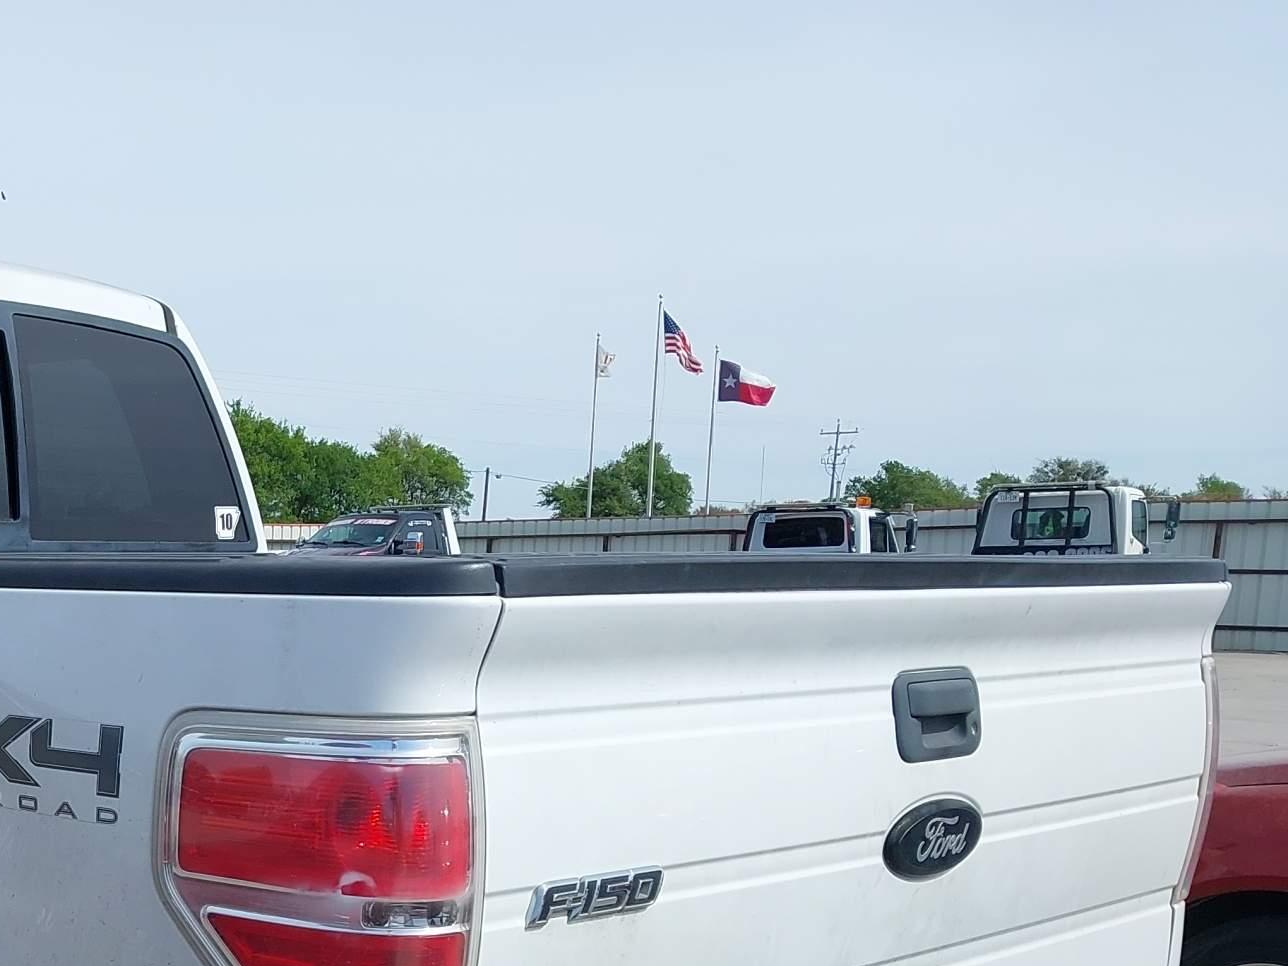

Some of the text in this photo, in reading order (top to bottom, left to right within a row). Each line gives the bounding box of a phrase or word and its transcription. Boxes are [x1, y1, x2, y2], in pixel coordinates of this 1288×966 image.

[219, 512, 233, 531] 10
[916, 815, 971, 863] Ford
[524, 865, 665, 931] F-150
